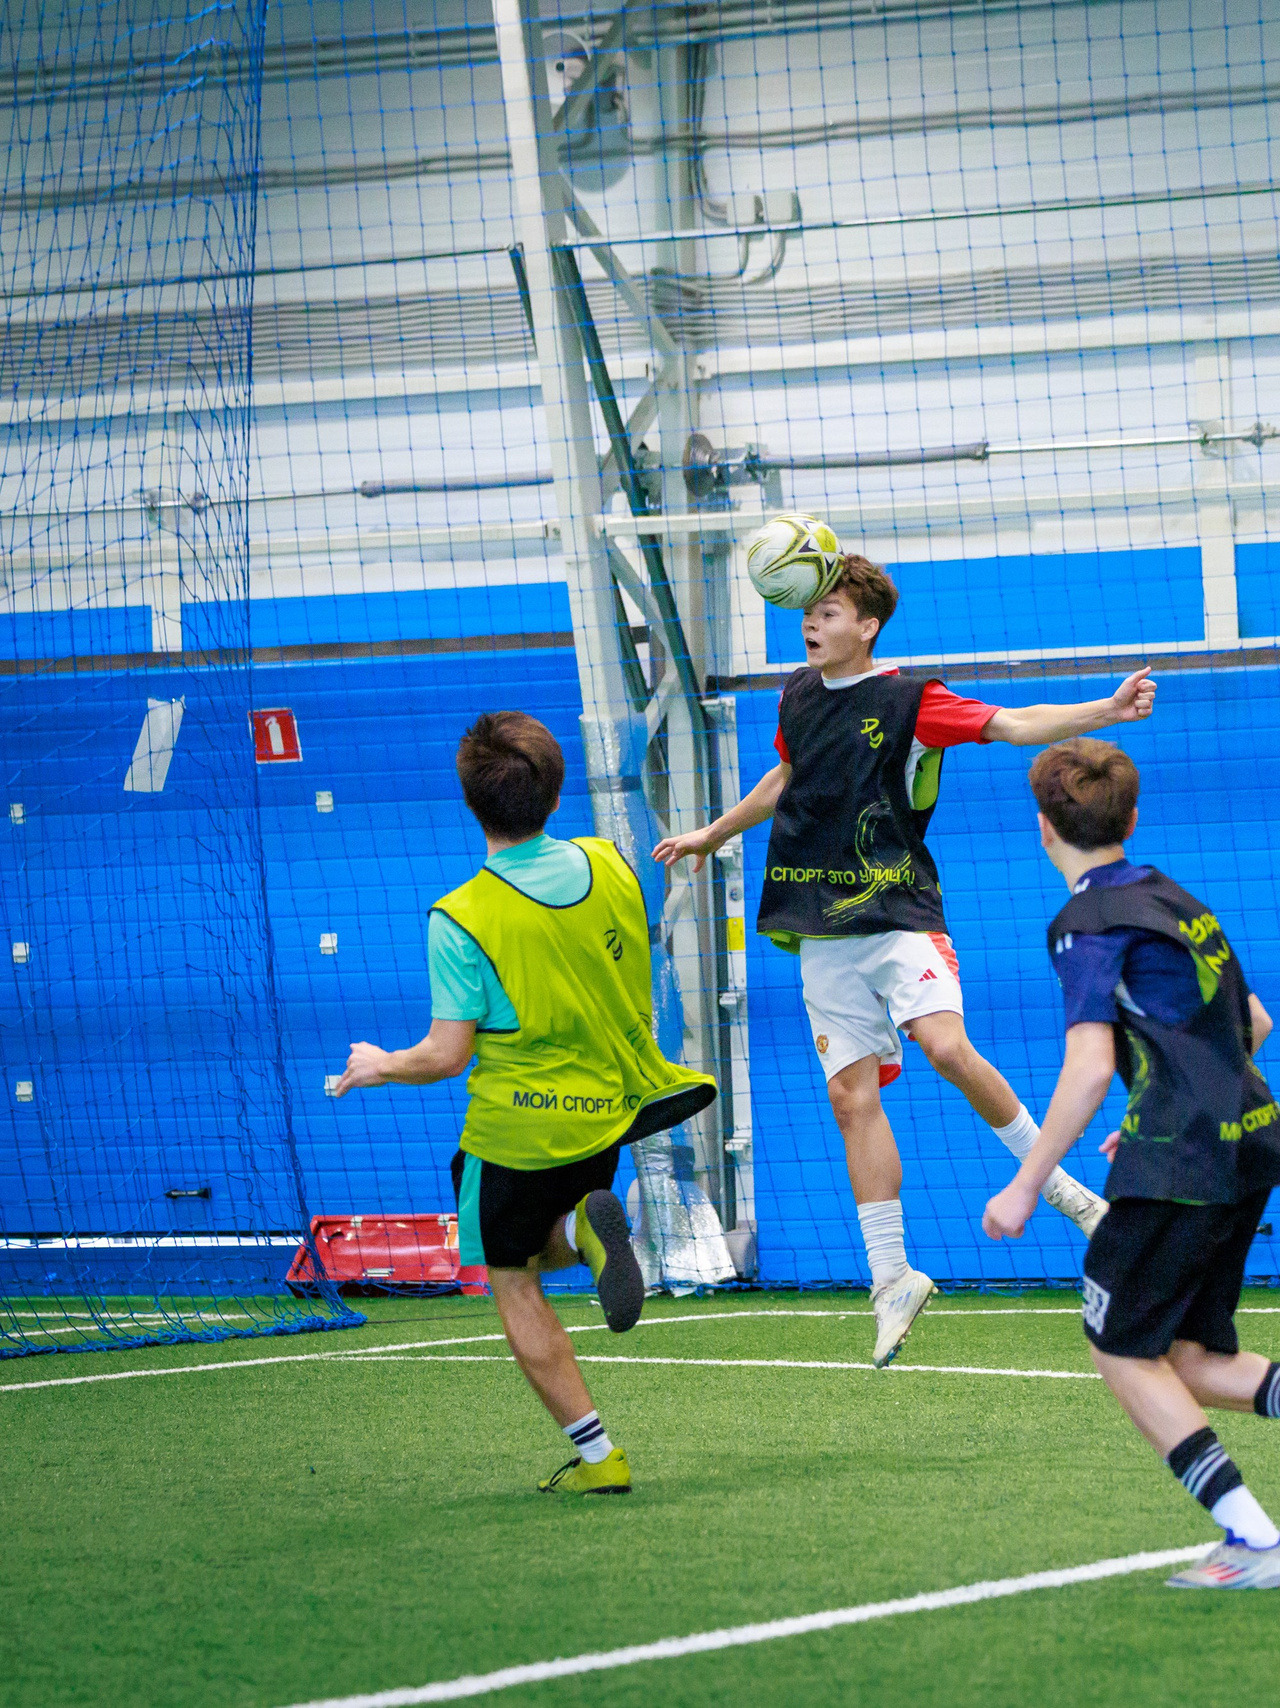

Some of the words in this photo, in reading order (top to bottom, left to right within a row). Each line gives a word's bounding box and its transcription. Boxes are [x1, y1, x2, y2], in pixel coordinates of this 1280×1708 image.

[828, 871, 856, 885] ЭТО
[513, 1089, 558, 1110] МОЙ
[562, 1095, 614, 1114] СПОРТ
